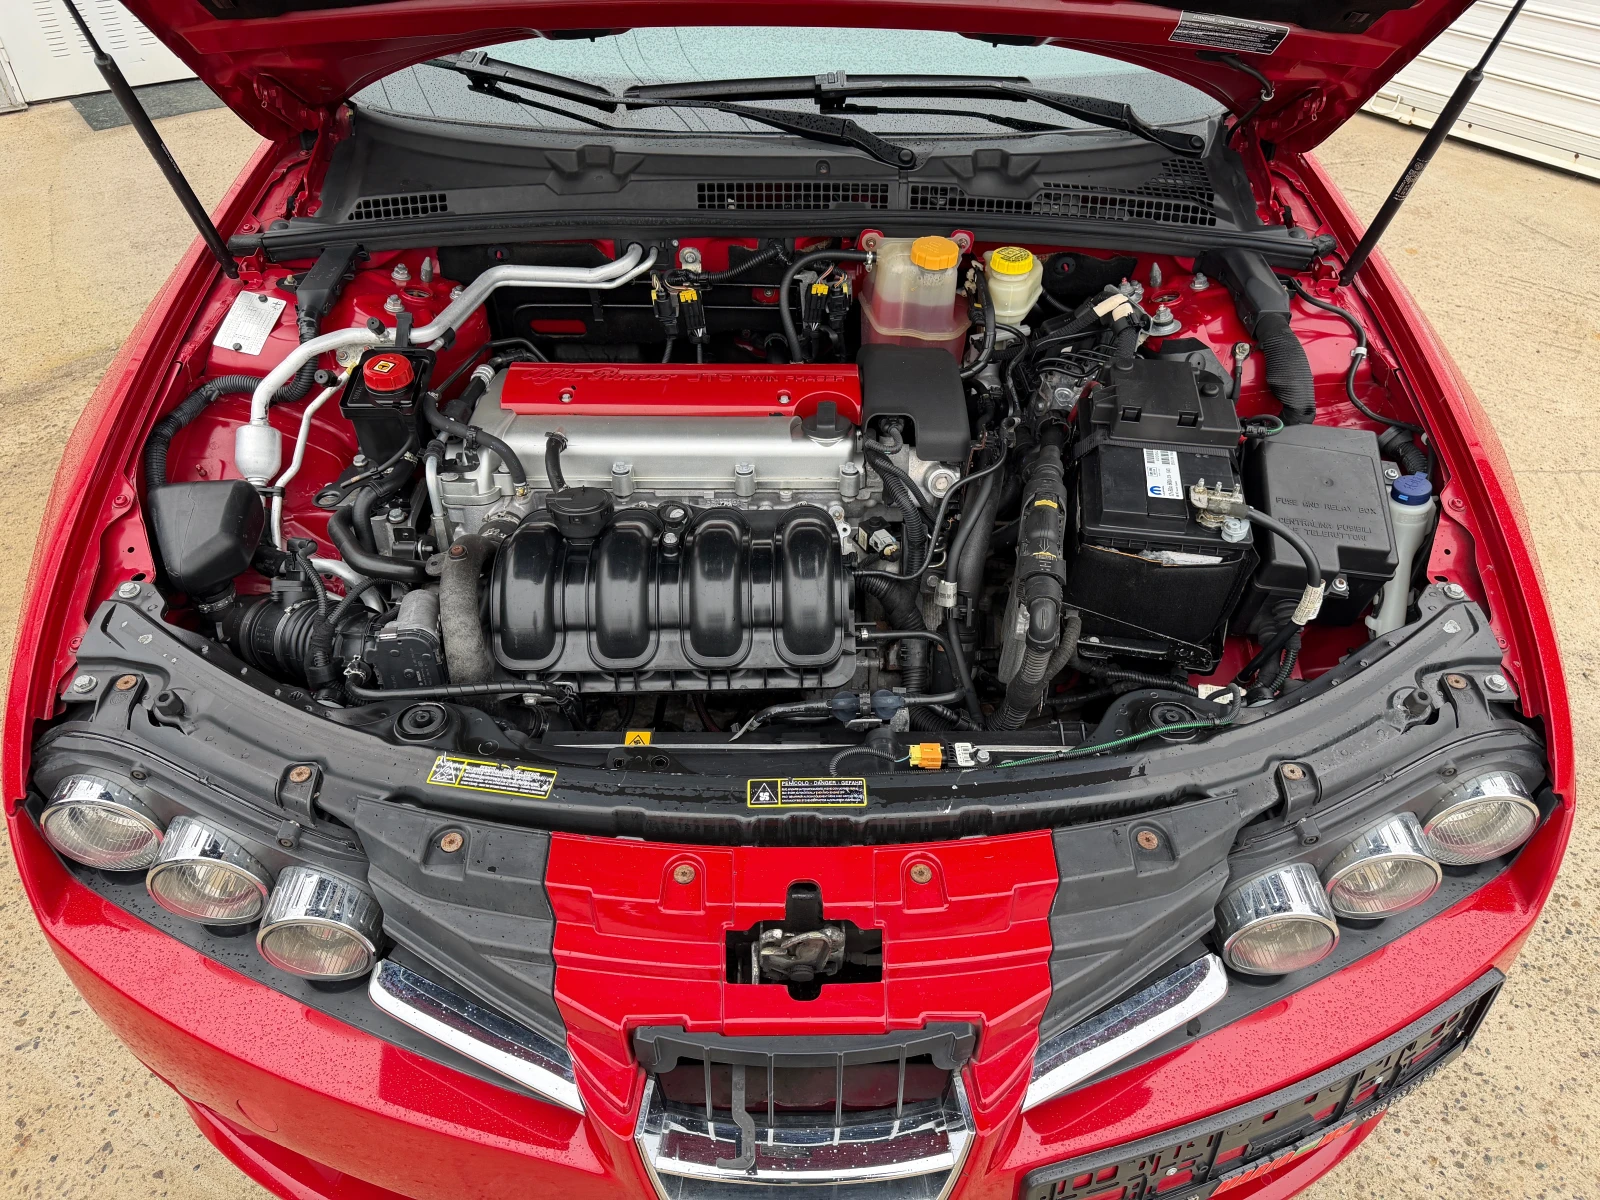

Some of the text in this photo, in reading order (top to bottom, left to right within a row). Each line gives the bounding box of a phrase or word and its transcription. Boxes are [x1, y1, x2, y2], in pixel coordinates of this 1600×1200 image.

[687, 373, 733, 383] JTS
[1275, 497, 1298, 506] FUSE
[1324, 503, 1352, 512] RELAY
[1358, 507, 1377, 515] BOX
